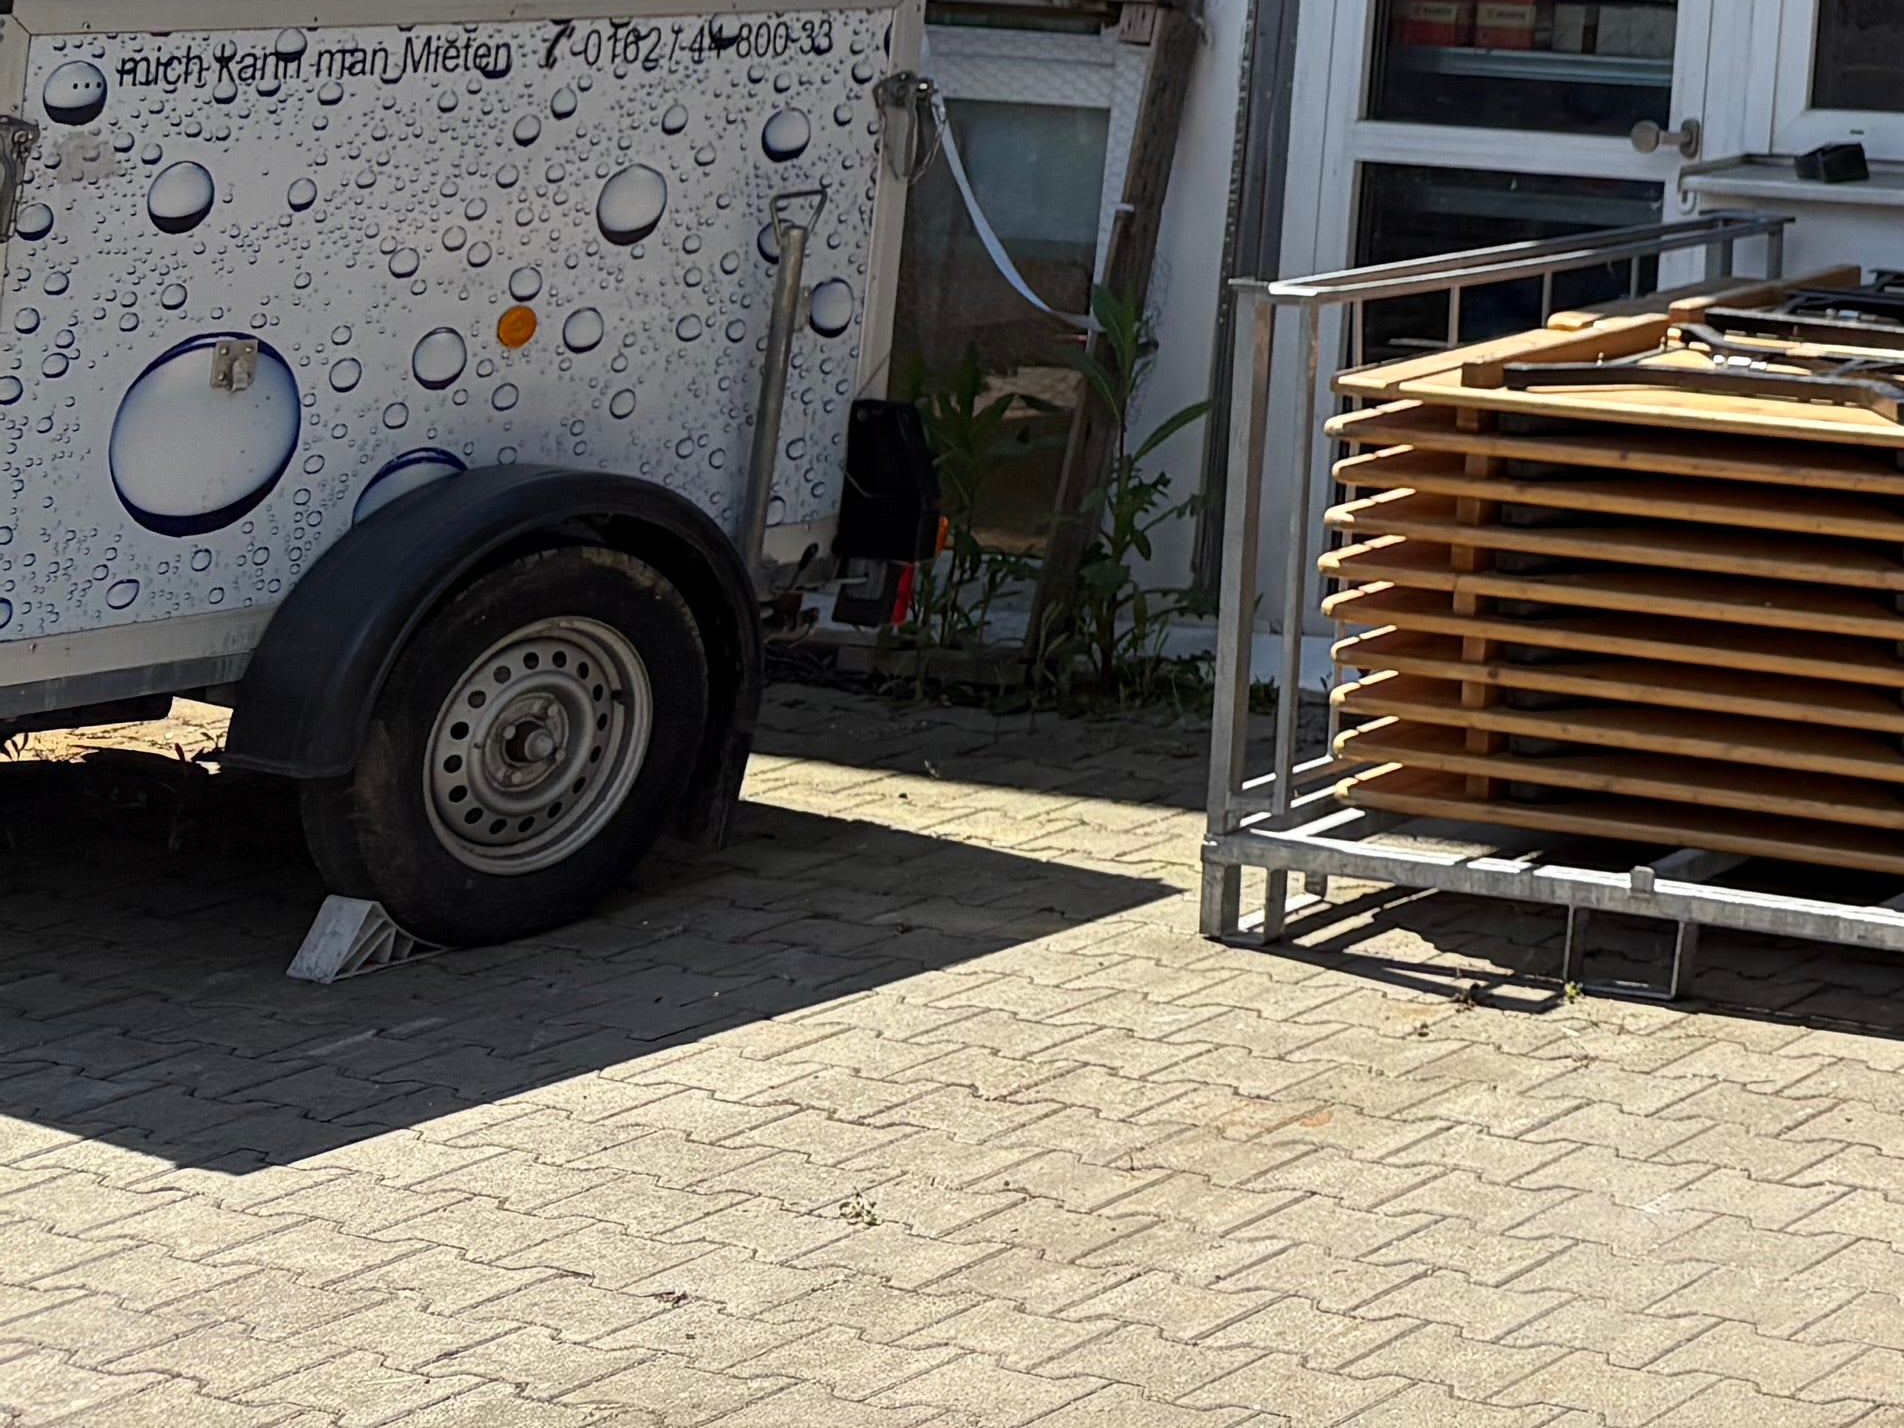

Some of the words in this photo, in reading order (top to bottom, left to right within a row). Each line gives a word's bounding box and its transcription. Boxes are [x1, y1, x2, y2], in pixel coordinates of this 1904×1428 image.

[118, 44, 203, 87] mich
[316, 47, 389, 79] man
[402, 34, 513, 74] Mieten
